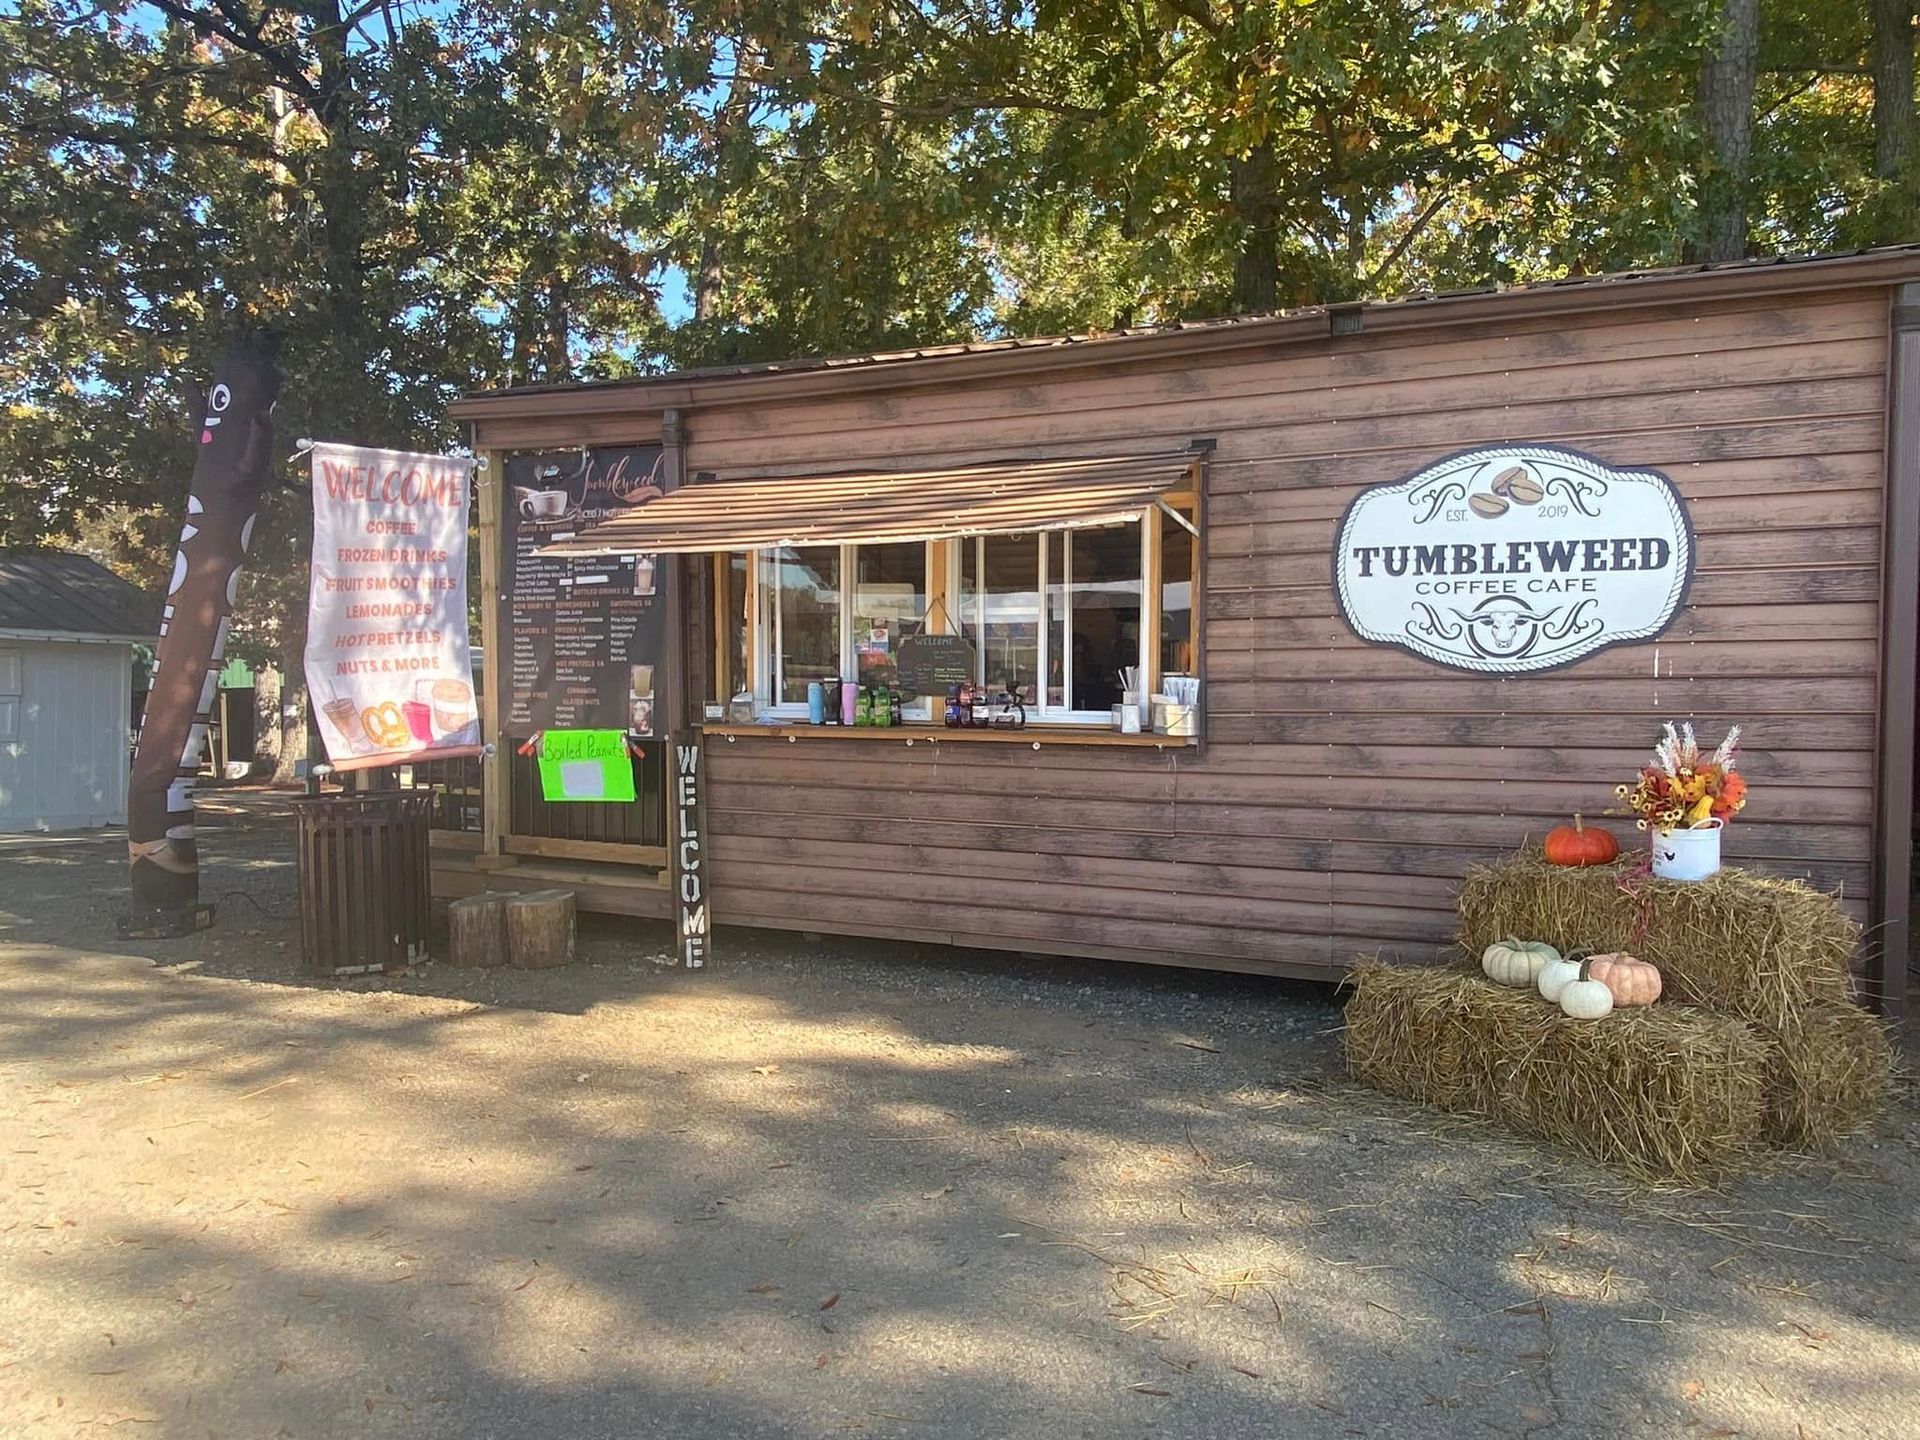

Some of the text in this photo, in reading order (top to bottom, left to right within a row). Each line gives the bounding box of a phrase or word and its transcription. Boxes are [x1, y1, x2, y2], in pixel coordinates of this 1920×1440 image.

[321, 460, 464, 507] WELCOME
[1446, 505, 1568, 522] EST. 2019
[366, 520, 416, 535] COFFEE
[337, 548, 447, 563] FROZEN DRINKS
[1353, 537, 1671, 577] TUMBLEWEED
[325, 577, 457, 592] FRUIT SMOOTHIES
[1415, 578, 1596, 595] COFFEE CAFE
[346, 603, 432, 619] LEMONADES
[335, 631, 441, 648] HOT PRETZELS
[336, 657, 440, 676] NUTS & MORE
[545, 735, 625, 761] Boiled Peanuts
[676, 745, 705, 968] WELCOME
